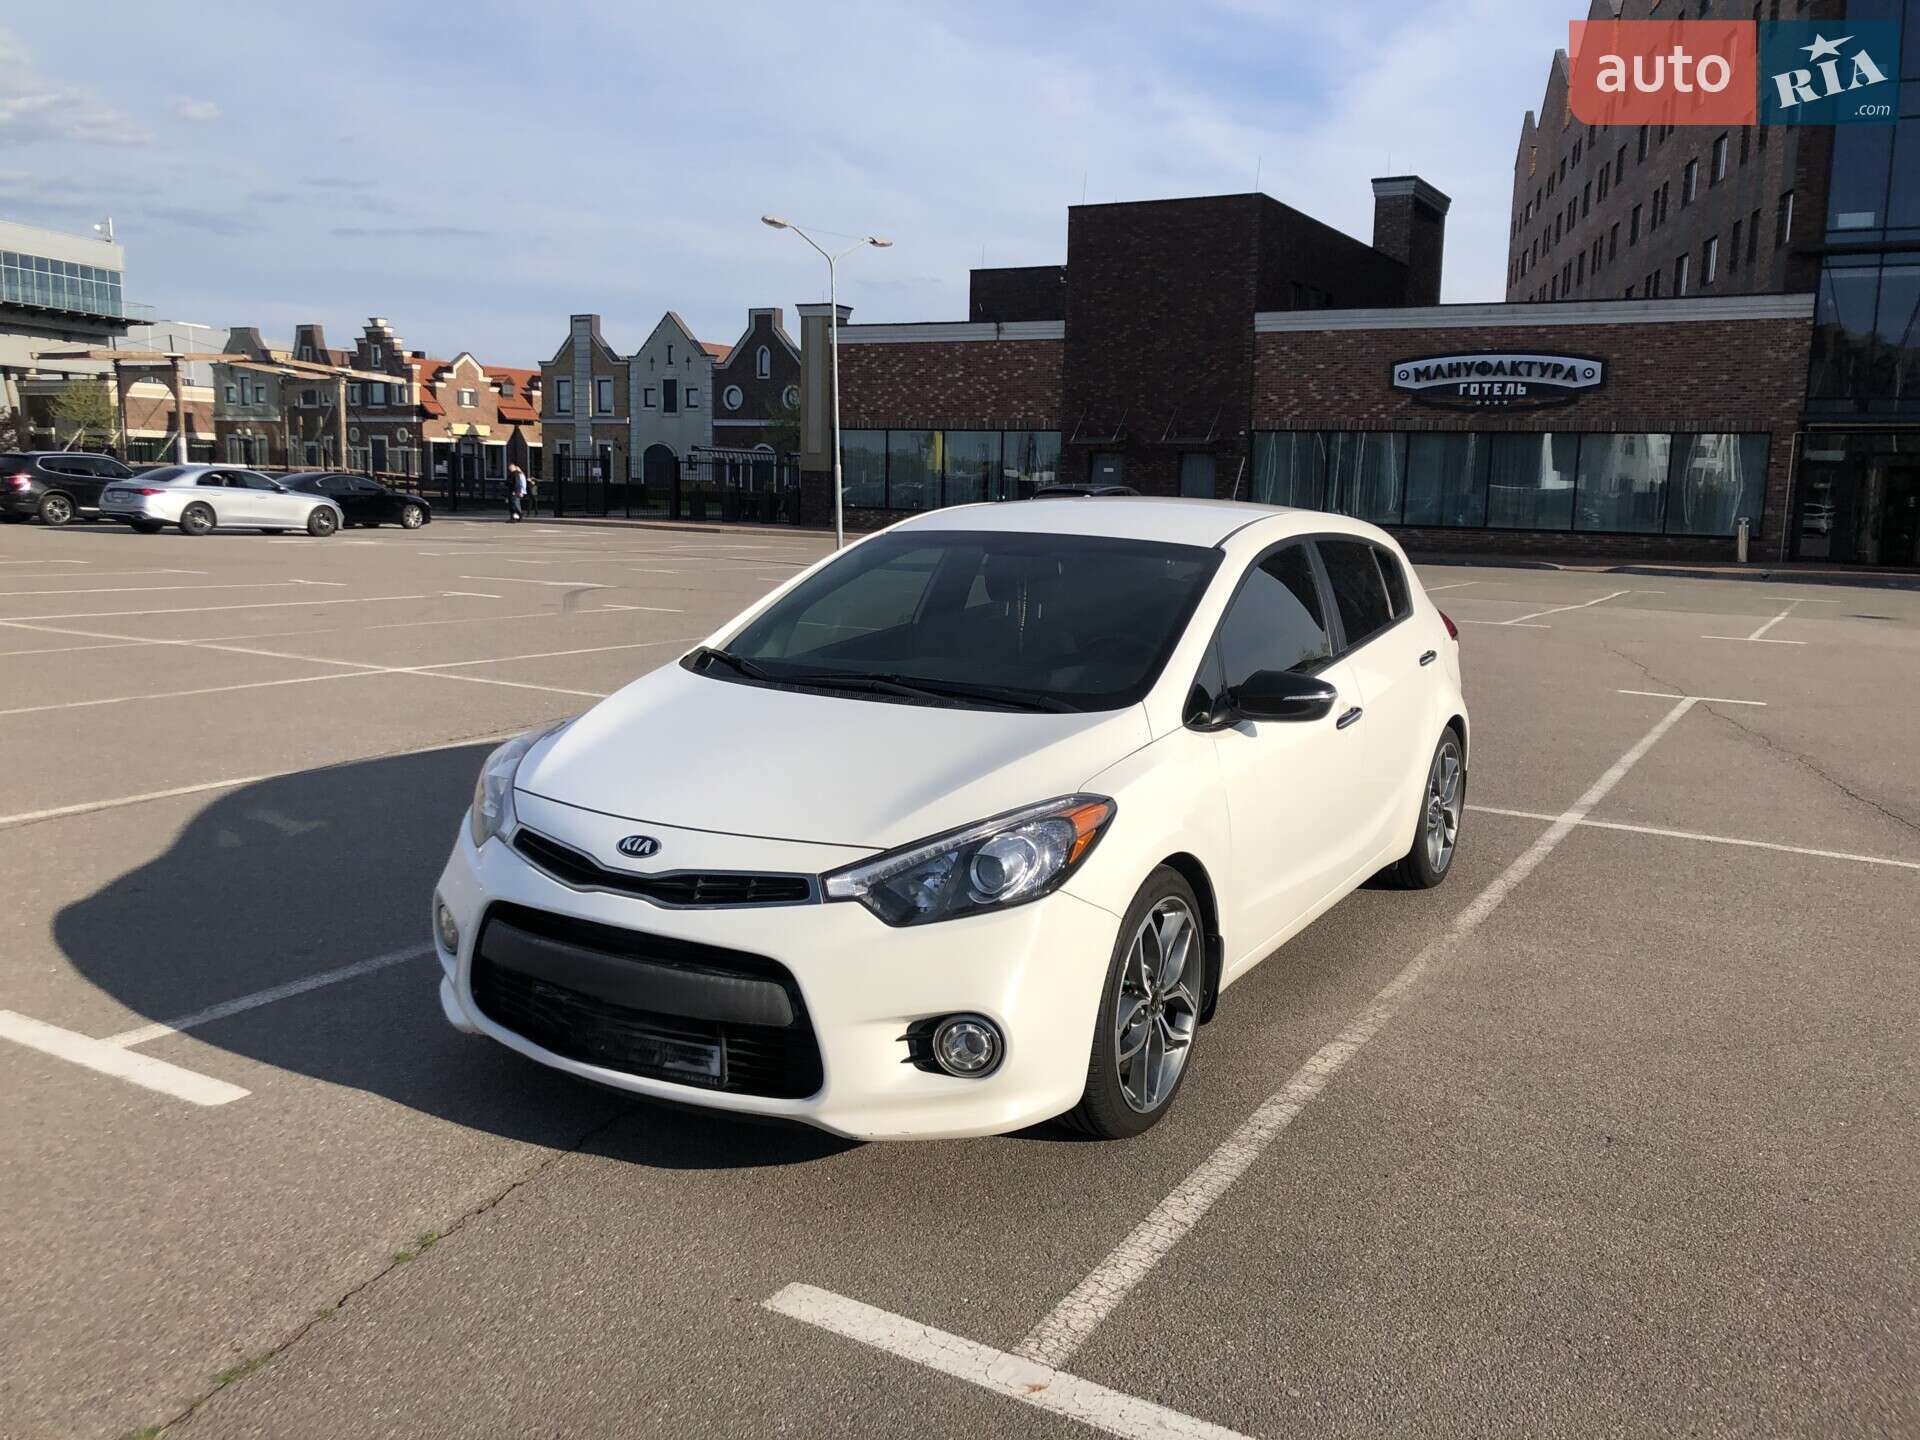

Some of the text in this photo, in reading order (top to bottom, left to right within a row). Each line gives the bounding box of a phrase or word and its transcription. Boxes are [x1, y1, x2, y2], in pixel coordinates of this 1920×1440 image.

[1413, 360, 1578, 382] МАНУФАКТУРА
[1459, 383, 1527, 396] ГОТЕЛЬ
[621, 837, 652, 854] KIA
